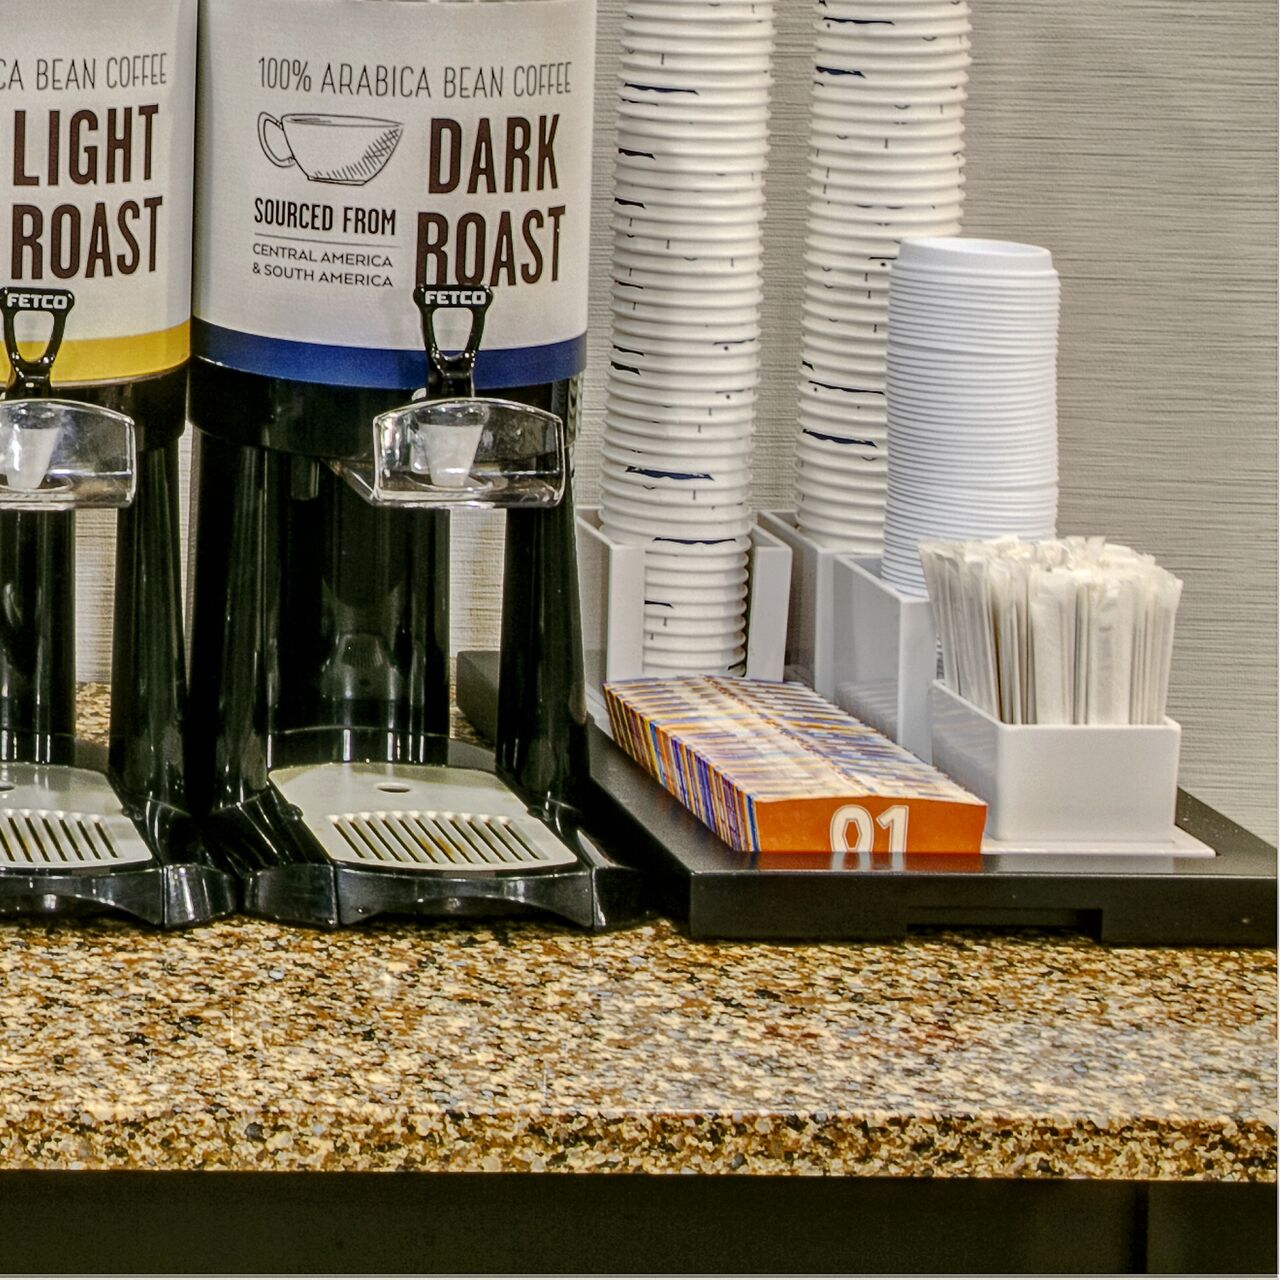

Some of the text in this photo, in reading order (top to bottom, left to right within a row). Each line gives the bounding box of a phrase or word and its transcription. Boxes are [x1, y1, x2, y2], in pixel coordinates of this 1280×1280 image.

[36, 57, 96, 90] BEAN
[106, 52, 167, 88] COFFEE
[258, 56, 572, 98] 100% ARABICA BEAN COFFEE
[12, 103, 159, 186] LIGHT
[428, 114, 561, 195] DARK
[254, 197, 396, 236] SOURCED FROM
[10, 195, 163, 280] ROAST
[252, 242, 394, 268] CENTRAL AMERICA
[415, 204, 567, 288] ROAST
[252, 262, 394, 288] & SOUTH AMERICA
[6, 293, 68, 310] FETCO
[424, 290, 487, 306] FETCO
[829, 804, 909, 852] 01
